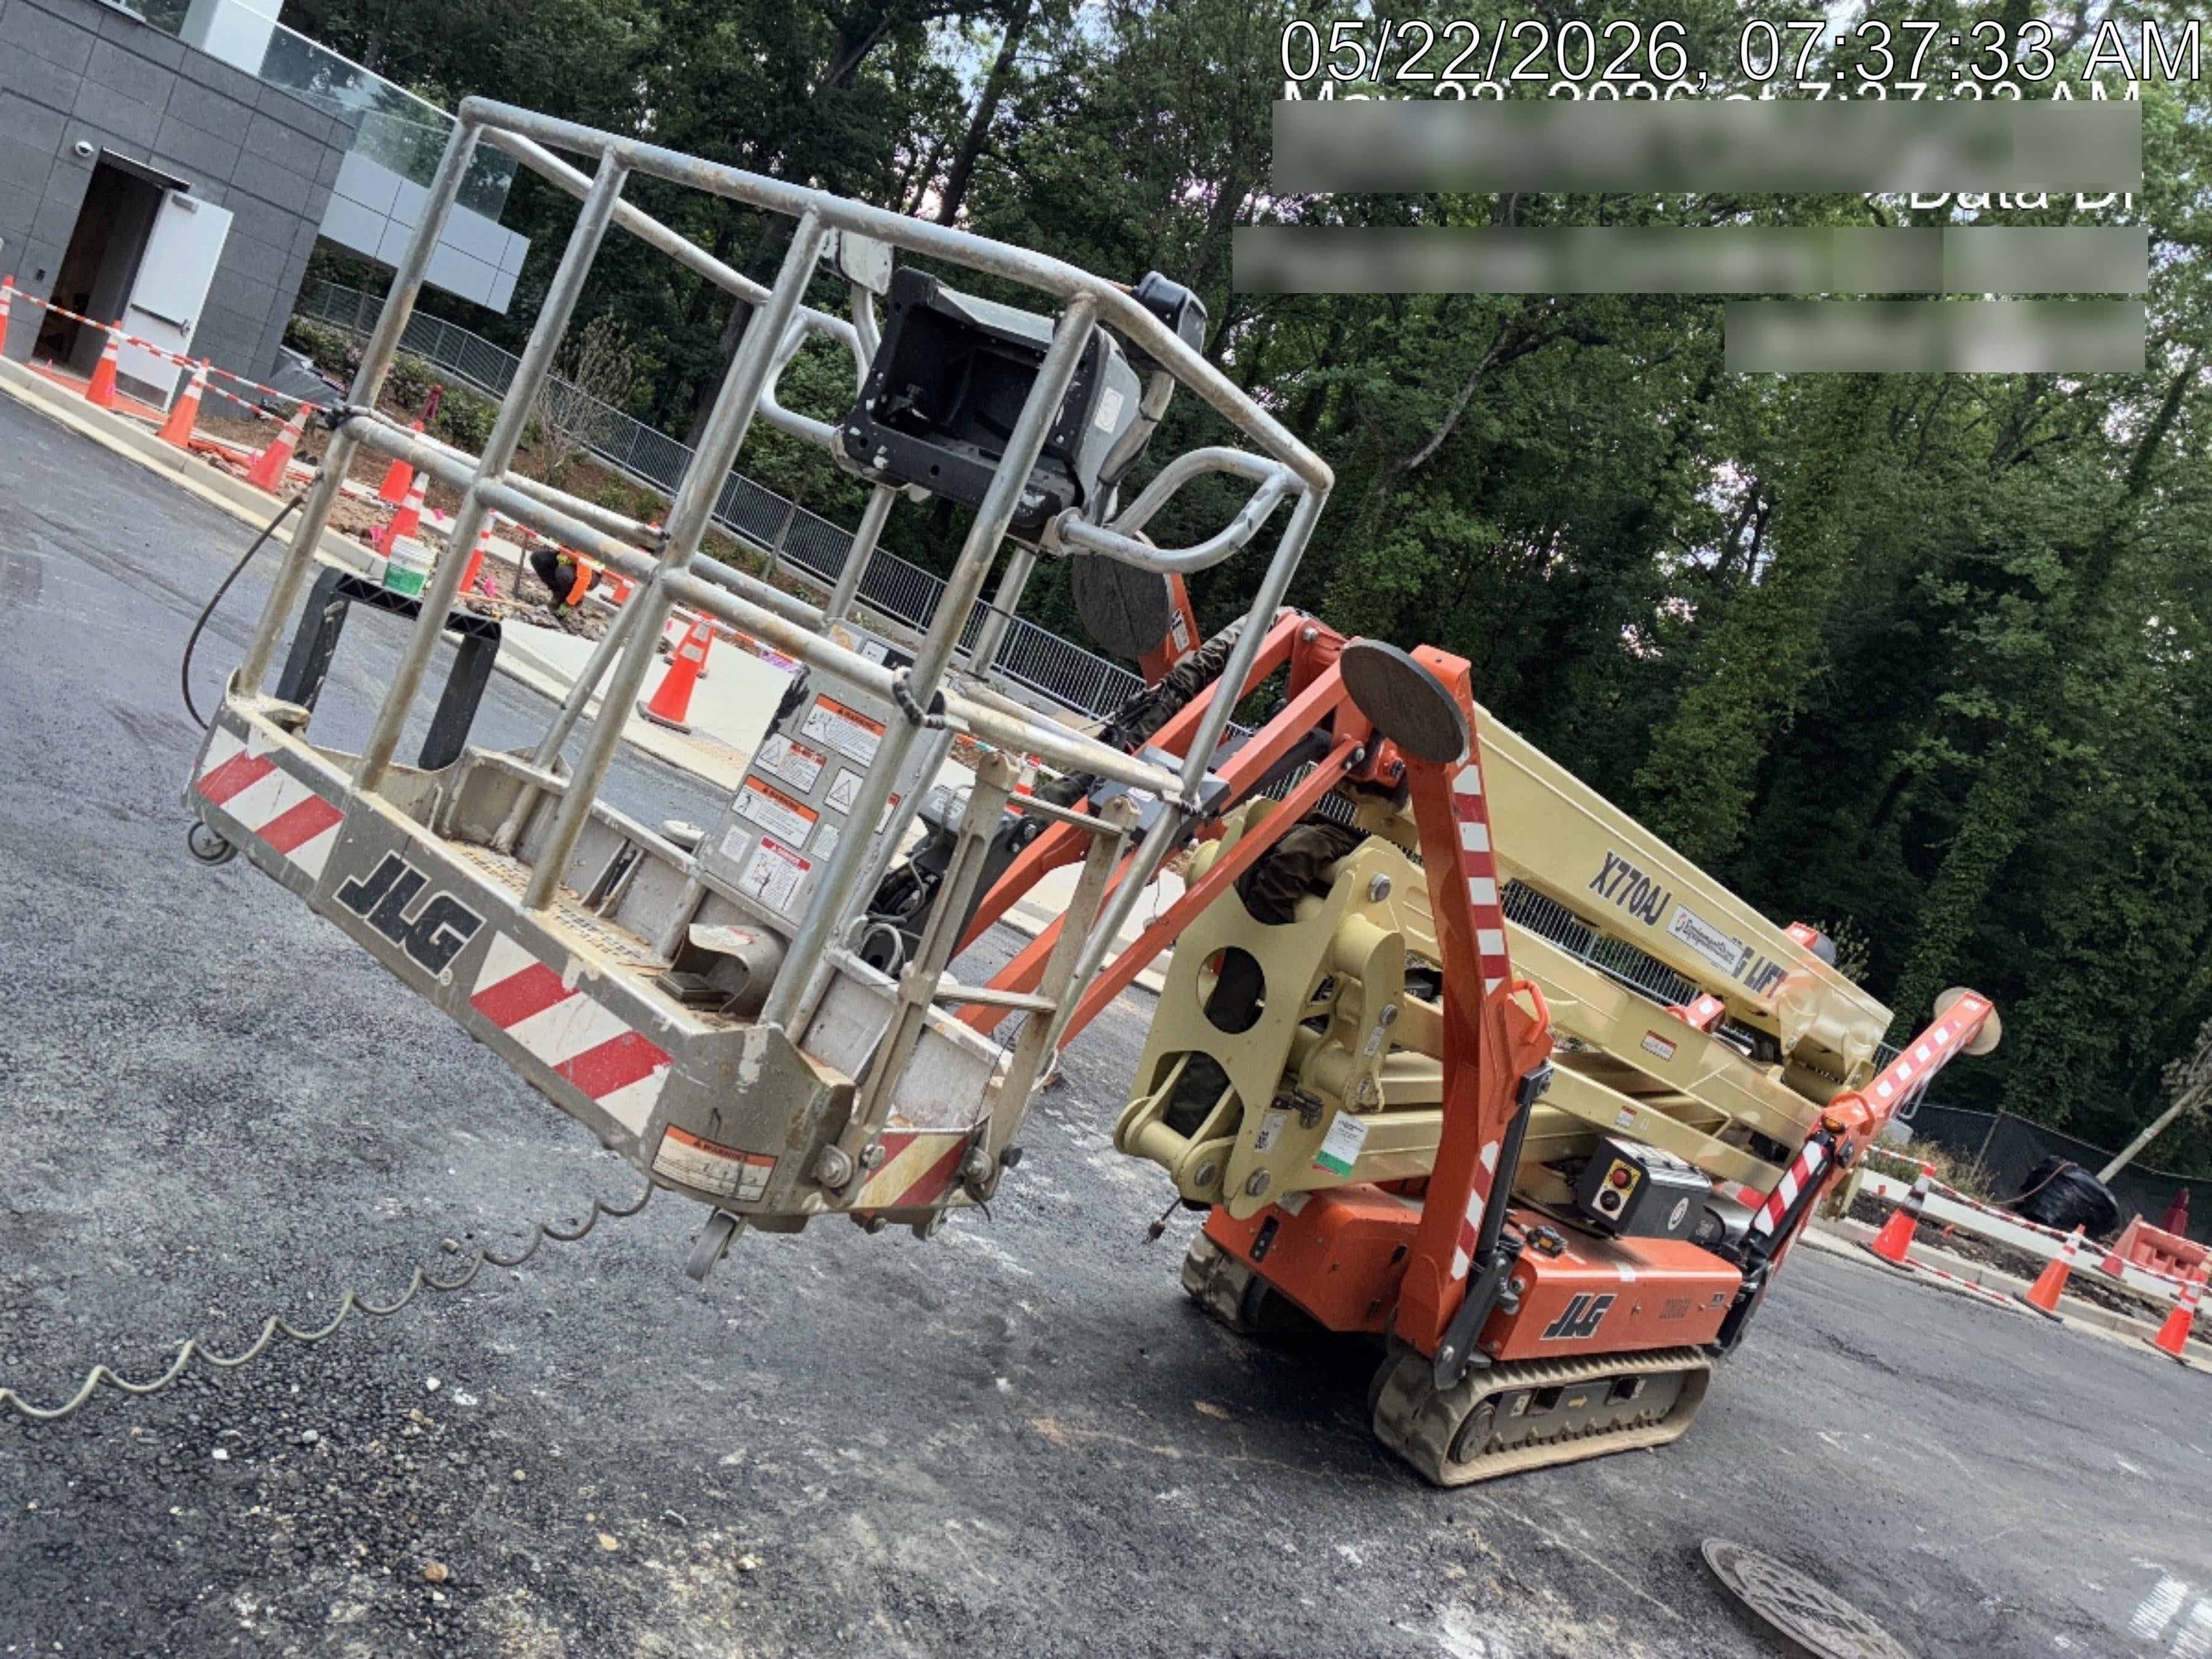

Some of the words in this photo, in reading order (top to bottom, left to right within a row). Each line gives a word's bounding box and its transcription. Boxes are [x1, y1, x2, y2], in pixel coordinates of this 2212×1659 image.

[332, 850, 487, 979] JLG
[1588, 850, 1673, 926] X770AJ
[1743, 955, 1789, 1000] LIFT
[1539, 1292, 1618, 1341] JLG
